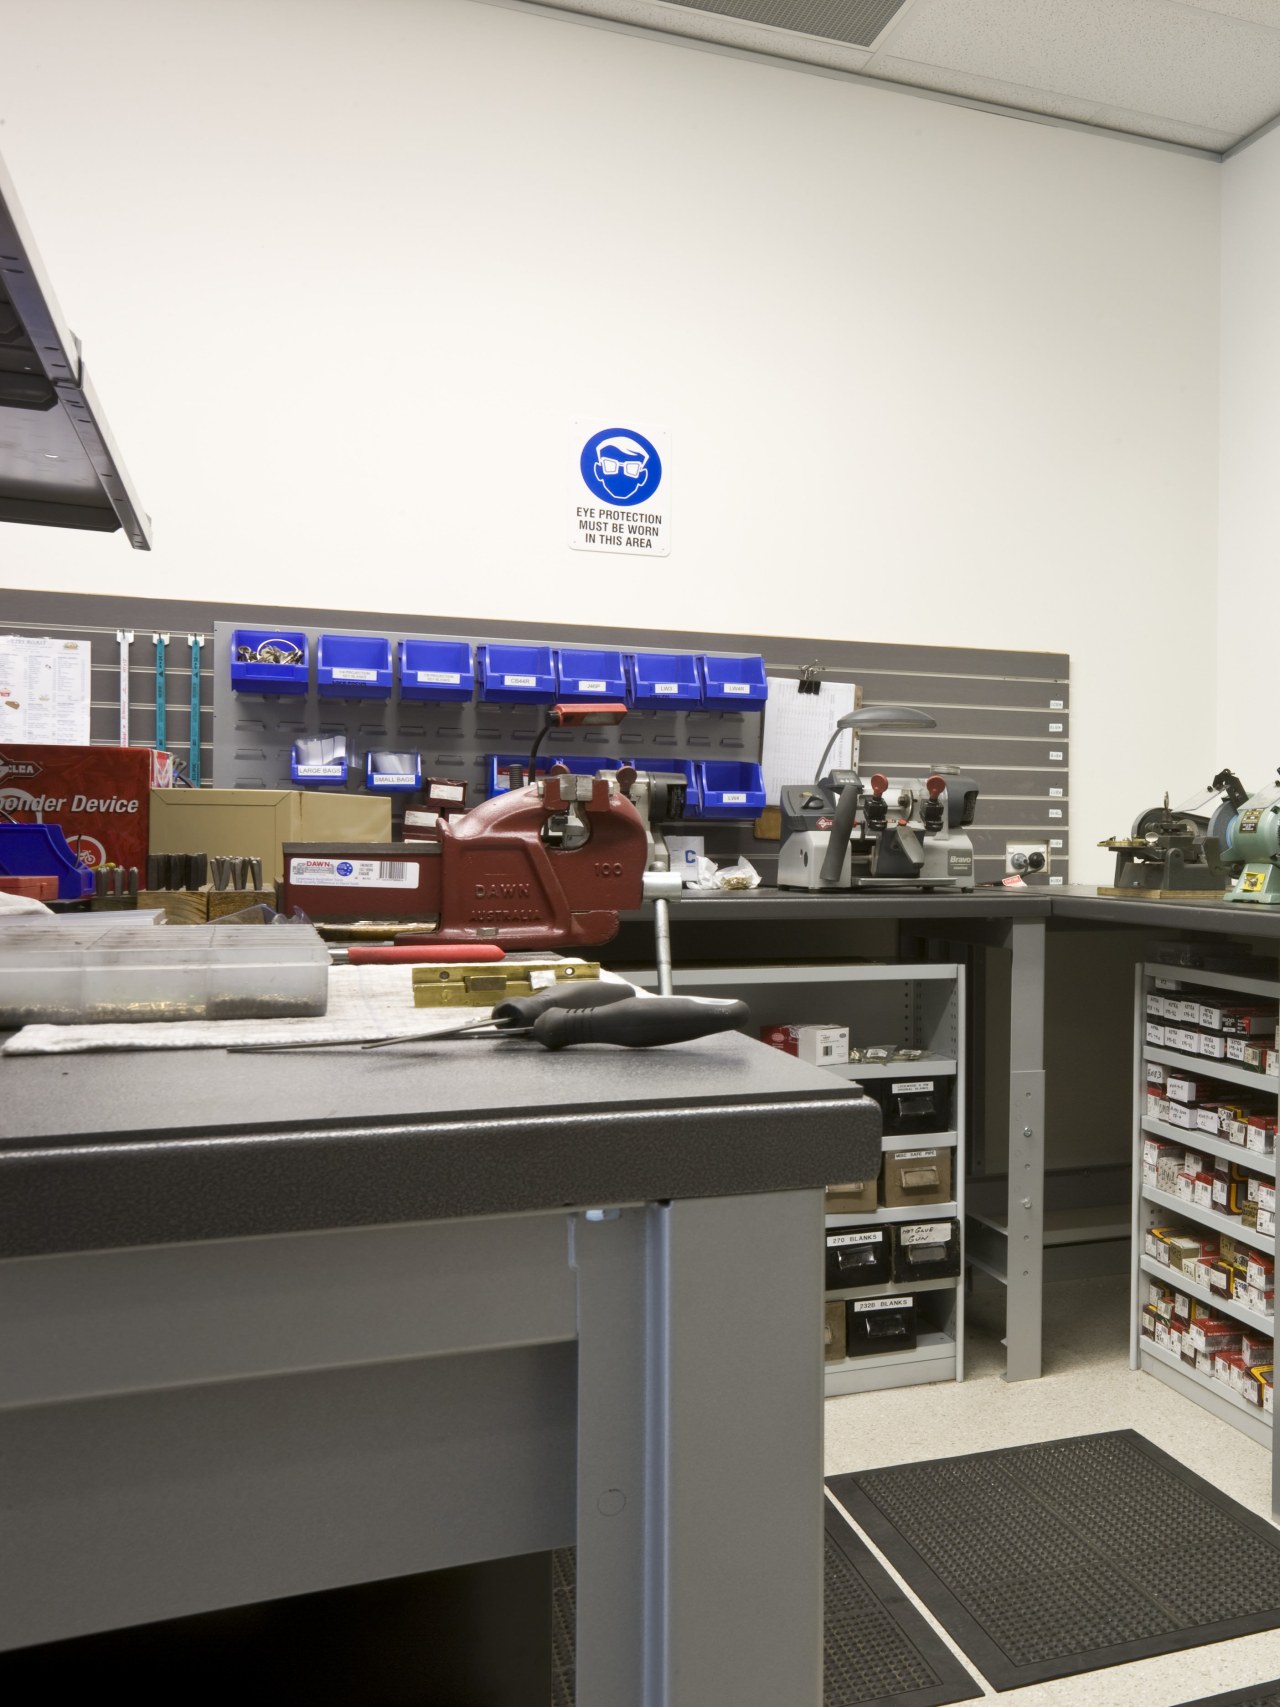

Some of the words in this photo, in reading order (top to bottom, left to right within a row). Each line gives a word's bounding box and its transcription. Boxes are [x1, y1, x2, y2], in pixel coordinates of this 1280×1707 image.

[576, 507, 595, 519] EYE
[599, 509, 662, 524] PROTECTION
[579, 520, 609, 532] MUST
[612, 523, 625, 533] BE
[627, 524, 659, 537] WORN
[585, 533, 596, 544] IN
[599, 534, 622, 546] THIS
[625, 537, 652, 548] AREA
[71, 795, 139, 813] Device
[685, 849, 696, 864] C
[950, 856, 972, 864] Bravo
[594, 862, 623, 877] 100
[475, 883, 530, 898] DAWN
[469, 909, 542, 922] AUSTRALIA
[850, 1234, 877, 1242] BLANKS
[908, 1235, 929, 1243] GUN
